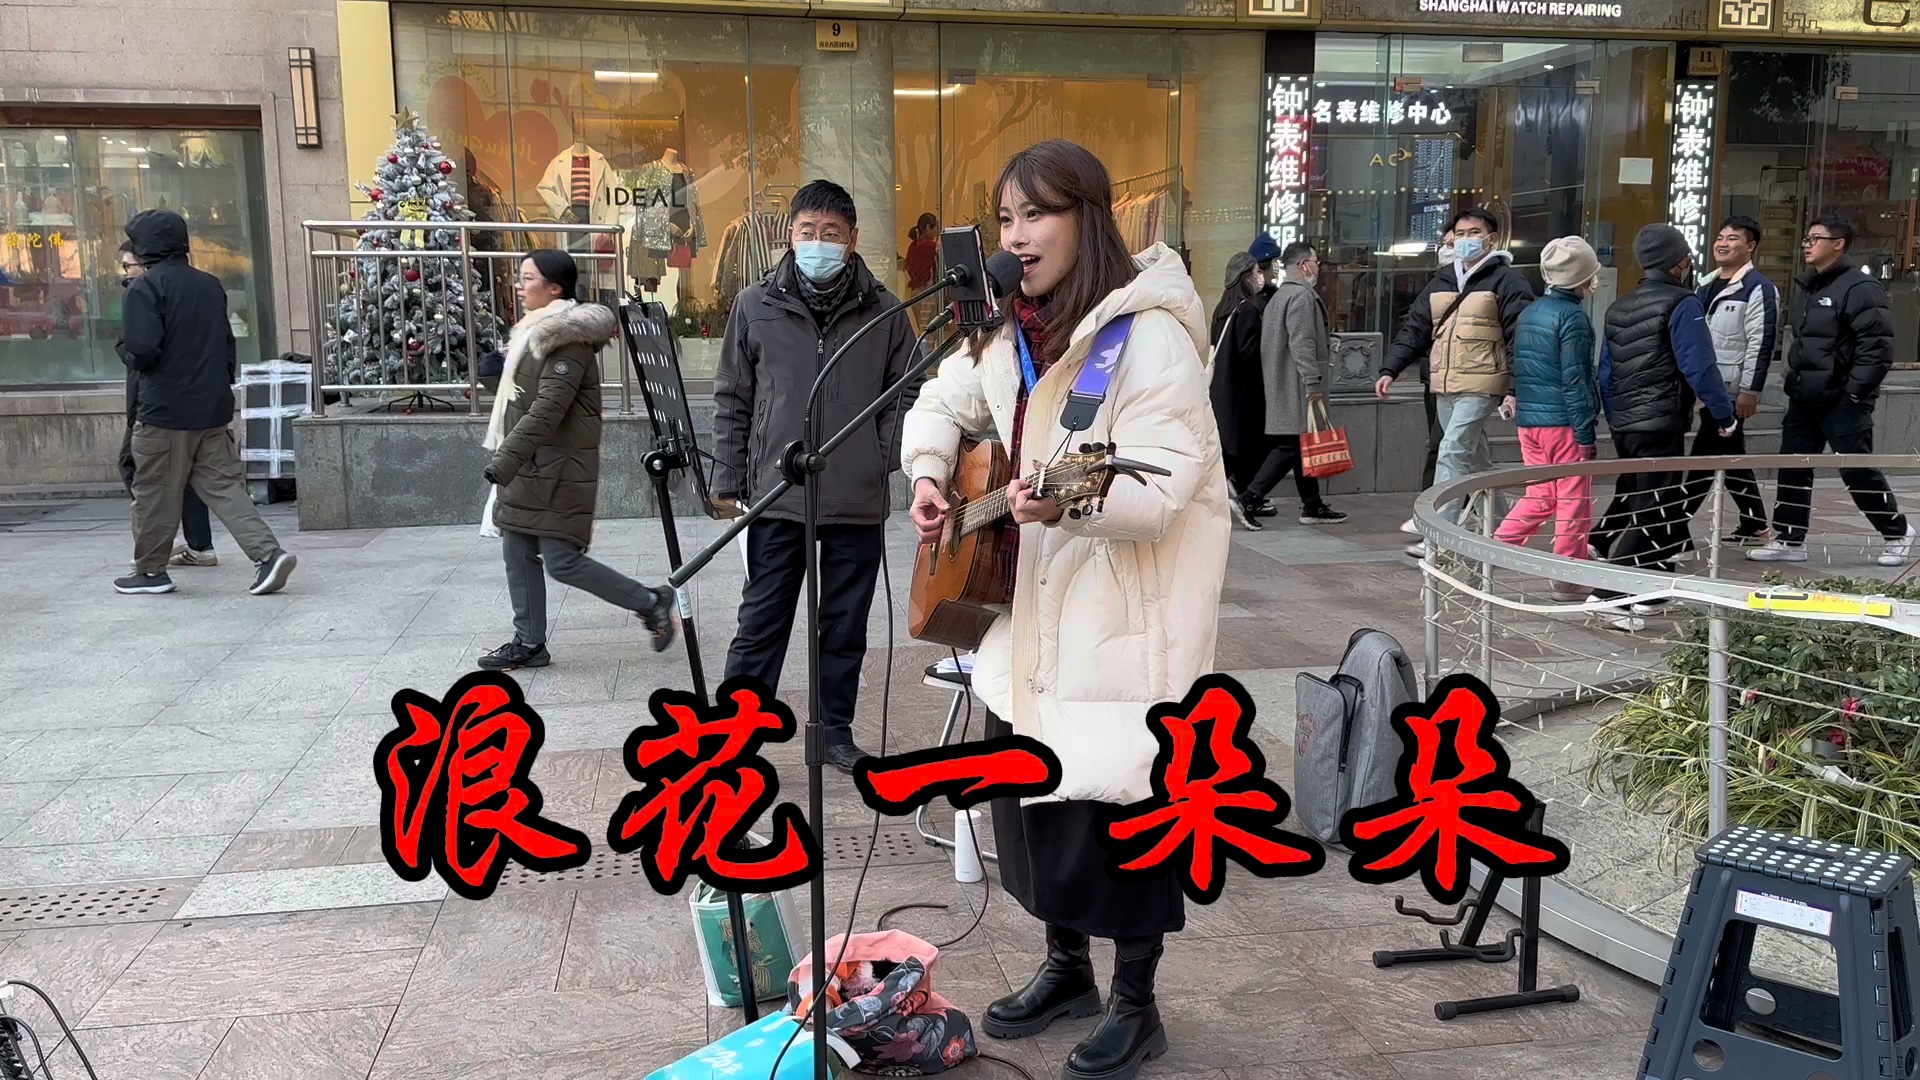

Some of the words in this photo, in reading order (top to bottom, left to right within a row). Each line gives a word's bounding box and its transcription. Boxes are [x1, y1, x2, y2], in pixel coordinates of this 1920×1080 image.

[1419, 0, 1494, 13] SHANGHAI
[1497, 1, 1550, 15] WATCH
[1549, 3, 1622, 18] REPAIRING
[832, 22, 841, 37] 9
[1700, 50, 1712, 63] 11
[1311, 98, 1452, 125] 名表维修中心
[605, 186, 685, 208] IDEAL
